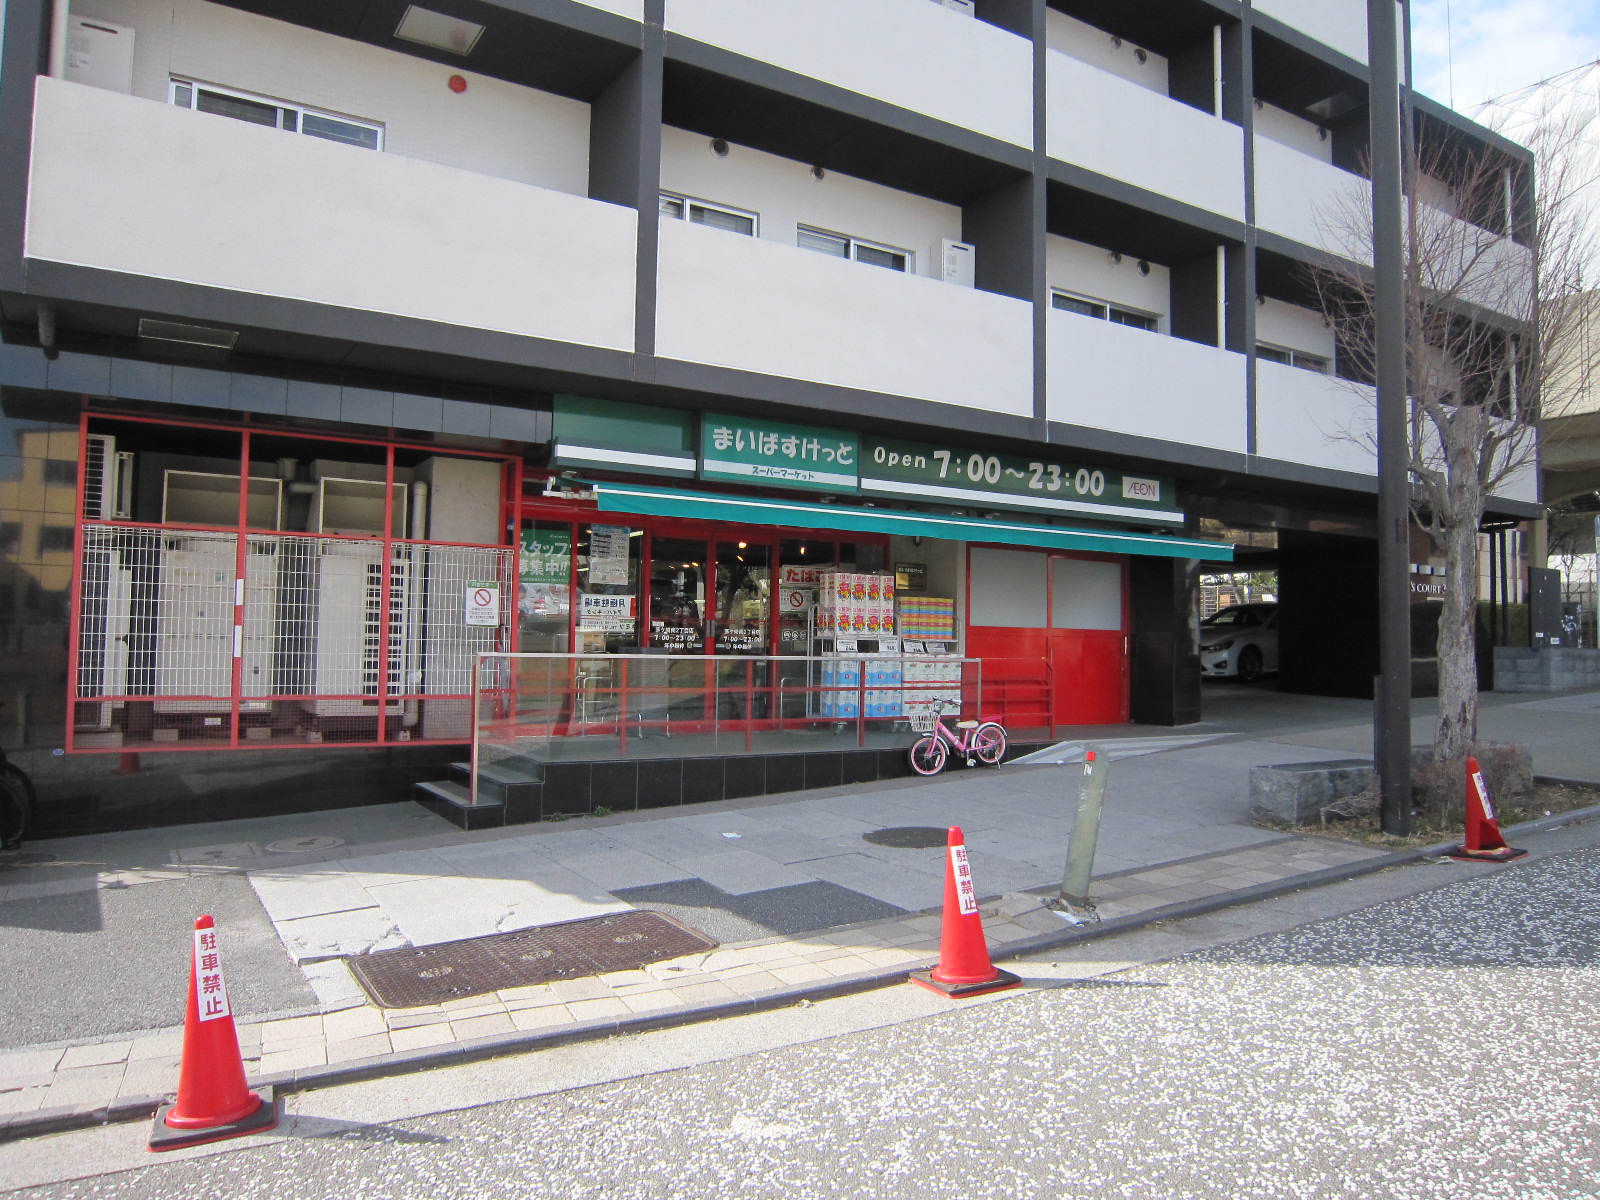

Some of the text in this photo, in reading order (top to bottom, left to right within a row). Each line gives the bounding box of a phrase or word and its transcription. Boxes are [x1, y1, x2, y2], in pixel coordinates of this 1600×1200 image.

[712, 426, 854, 465] まいばすけっと
[874, 446, 926, 468] Open
[752, 465, 814, 481] スーパーマーケット
[520, 541, 568, 557] スタッフ
[1416, 583, 1441, 594] COURT
[955, 849, 976, 911] 駐車禁止
[200, 932, 224, 1016] 駐車禁止
